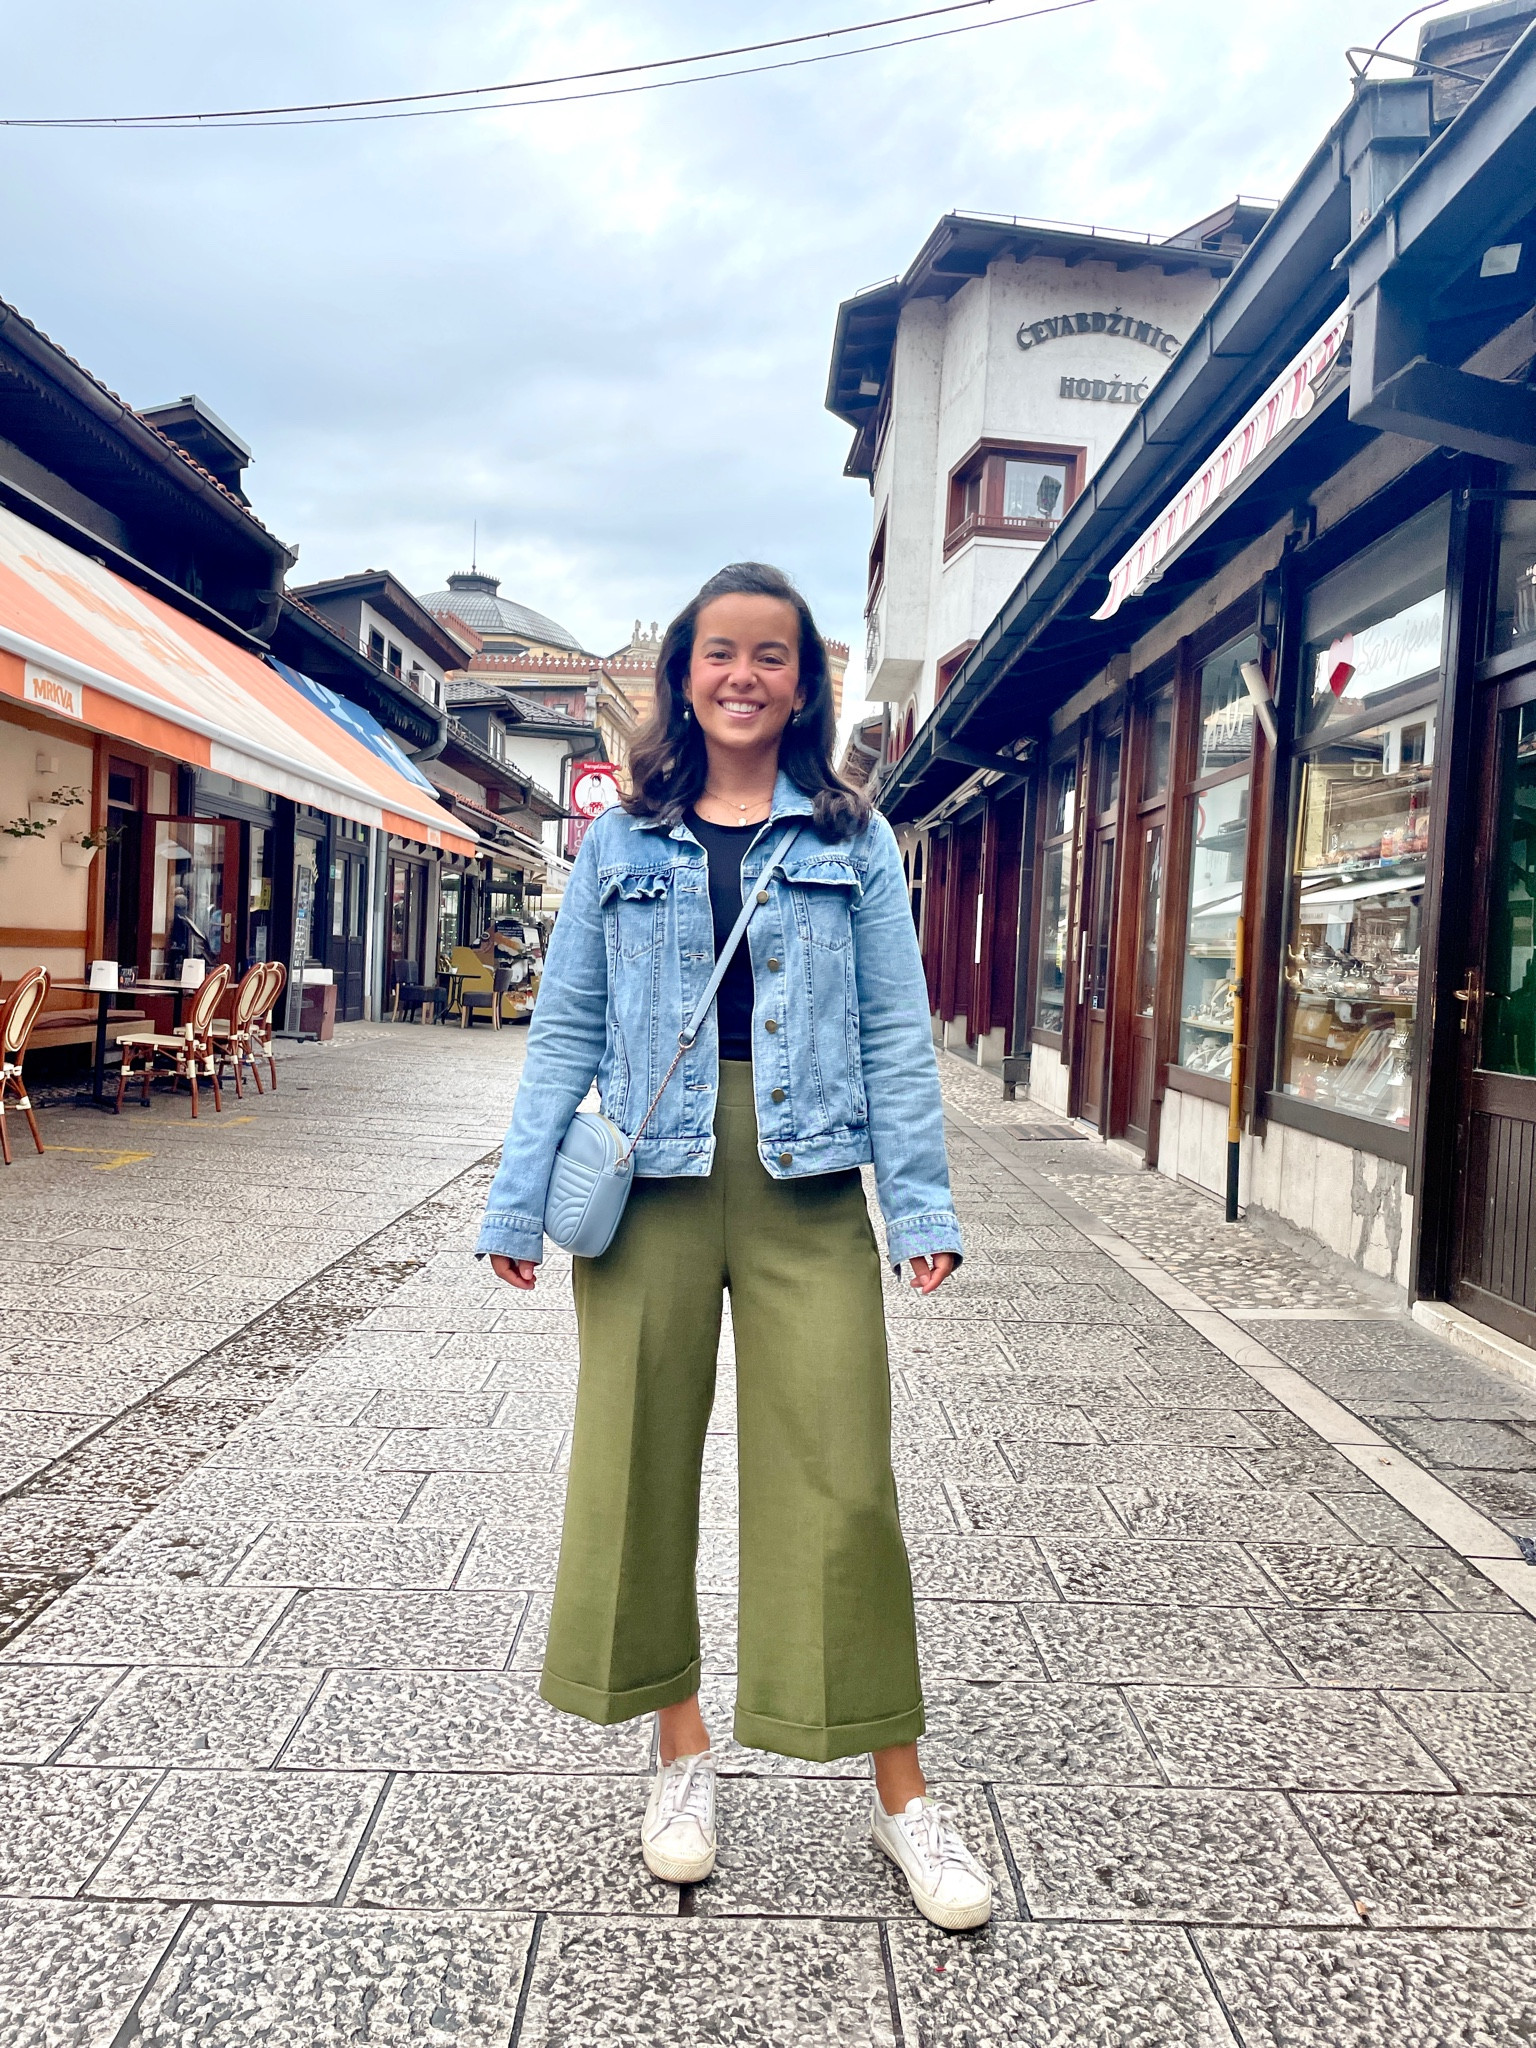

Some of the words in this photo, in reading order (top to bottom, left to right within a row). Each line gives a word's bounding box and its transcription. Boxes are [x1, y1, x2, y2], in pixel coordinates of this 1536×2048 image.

[1016, 306, 1182, 360] ĆEVABDŽINIC
[1059, 373, 1150, 404] HODŽIĆ
[32, 677, 74, 714] MRKVA
